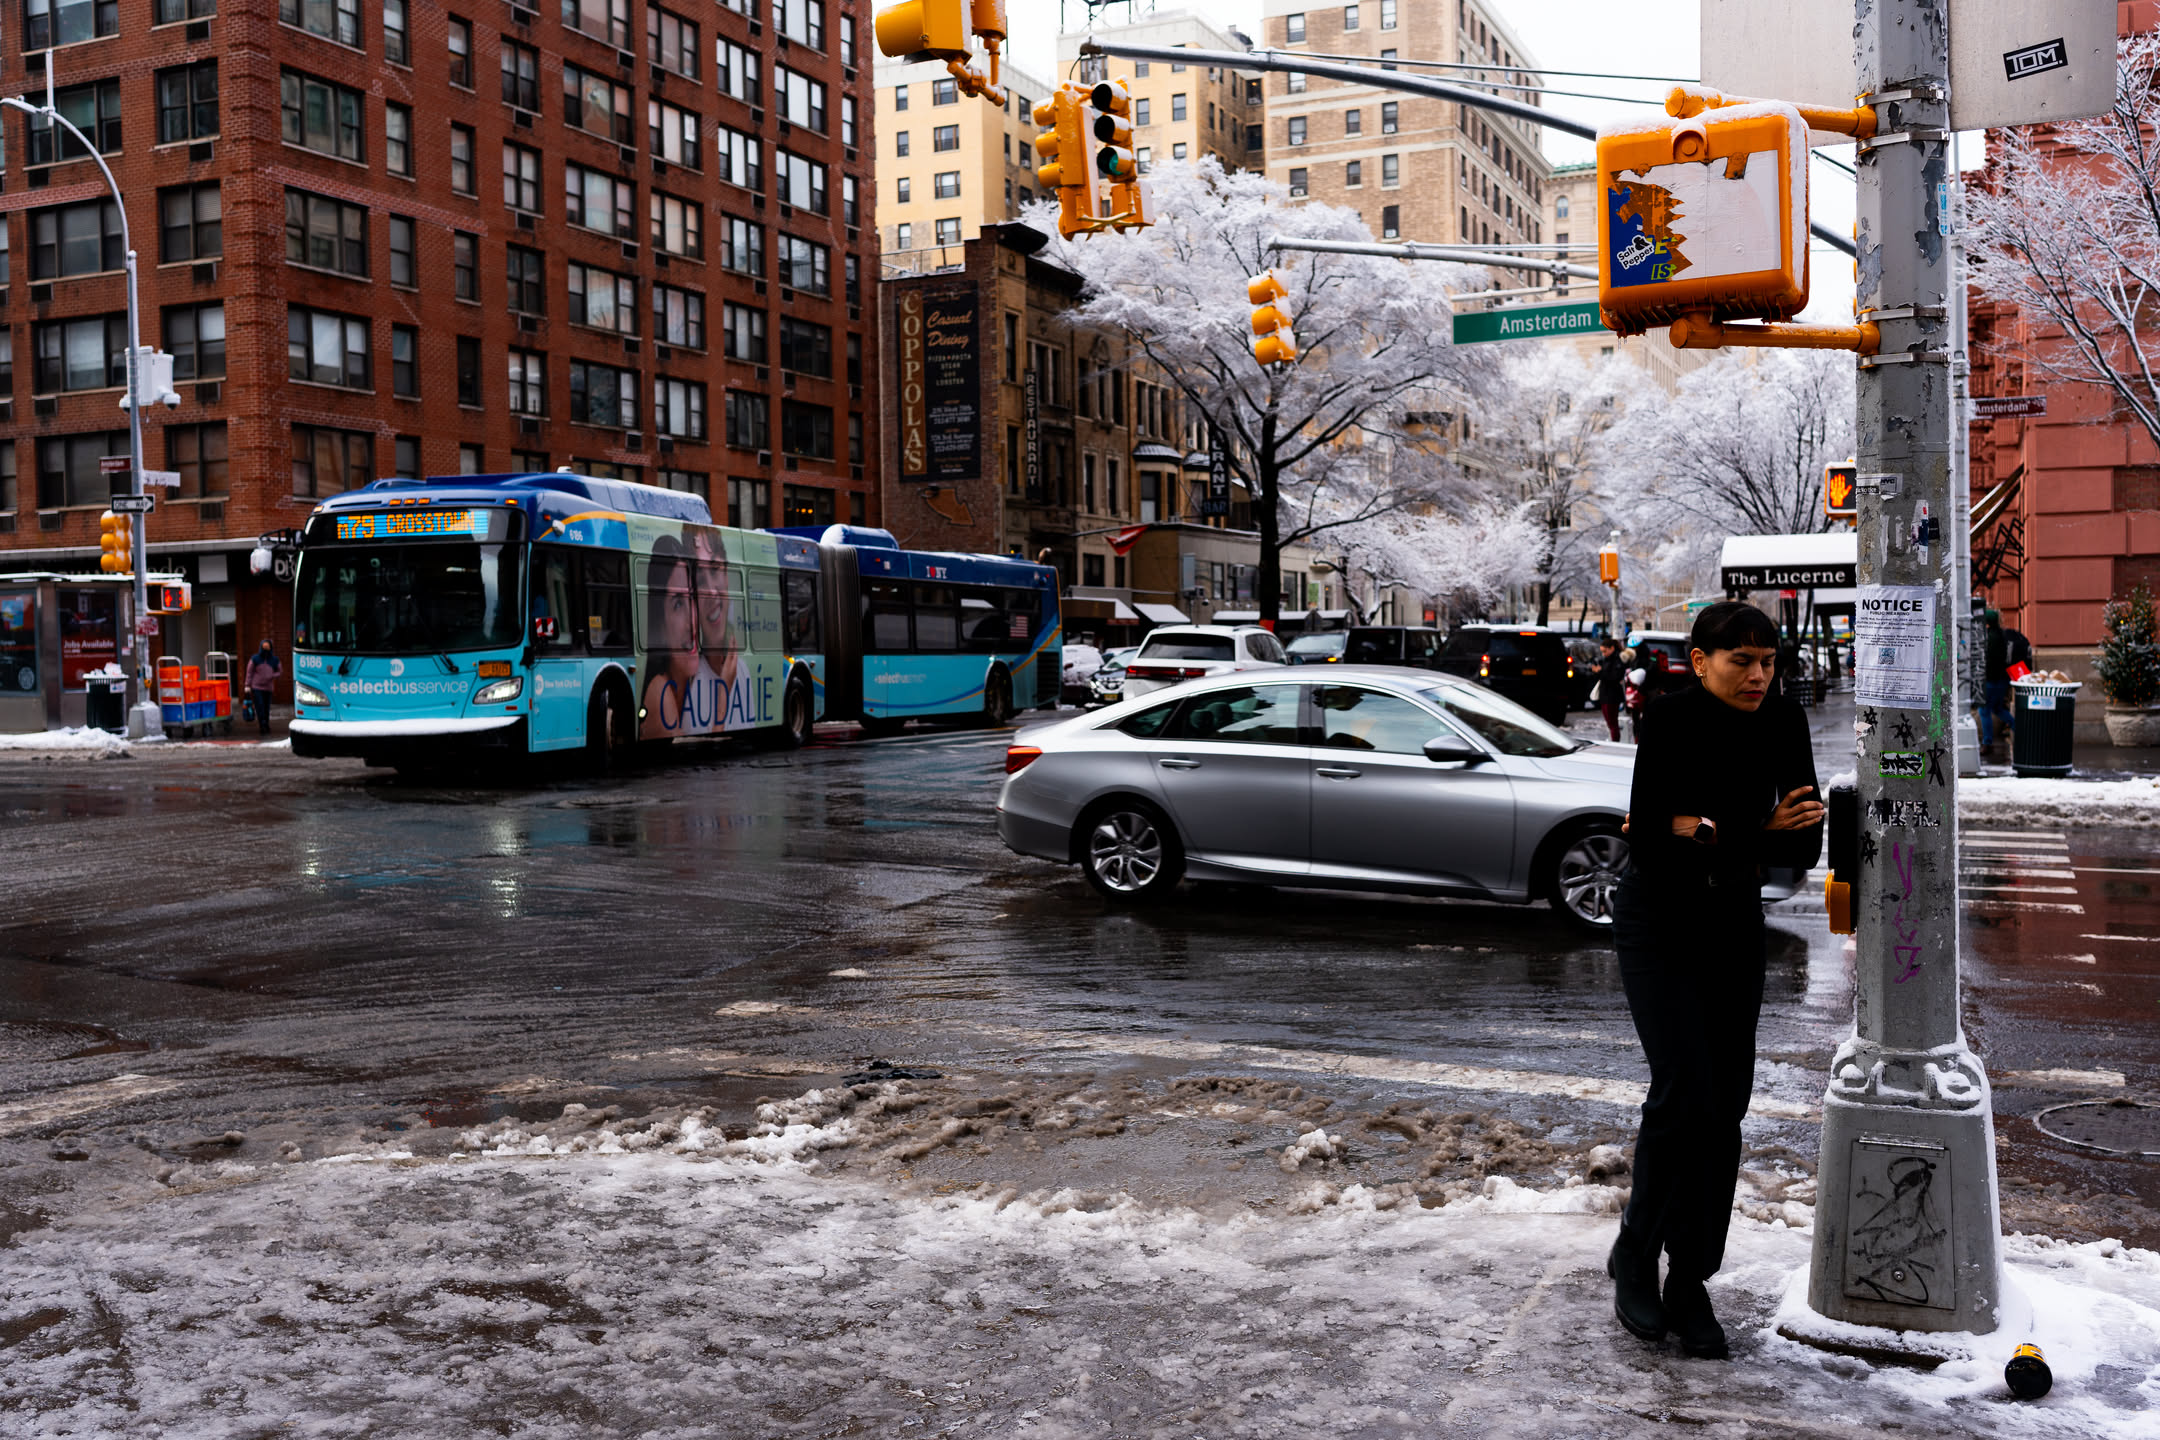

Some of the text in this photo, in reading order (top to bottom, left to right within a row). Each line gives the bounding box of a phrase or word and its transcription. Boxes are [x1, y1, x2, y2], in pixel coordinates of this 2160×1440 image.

[2006, 42, 2063, 78] TOM.
[1618, 246, 1635, 261] Salt
[1623, 246, 1653, 268] Pepper
[927, 309, 972, 328] Casual
[1500, 312, 1591, 334] Amsterdam
[928, 331, 968, 349] Dining
[903, 291, 924, 472] COPPOLA'S
[1976, 403, 2029, 414] Amsterdam
[1026, 374, 1037, 486] RESTAURANT
[136, 500, 149, 508] WAY
[337, 511, 475, 539] M79 CROSSTOWN
[1728, 569, 1846, 585] The Lucerne
[1862, 598, 1923, 612] NOTICE
[64, 640, 114, 648] Jobs Available
[299, 656, 322, 669] 6186
[329, 679, 469, 695] +selectbusservice
